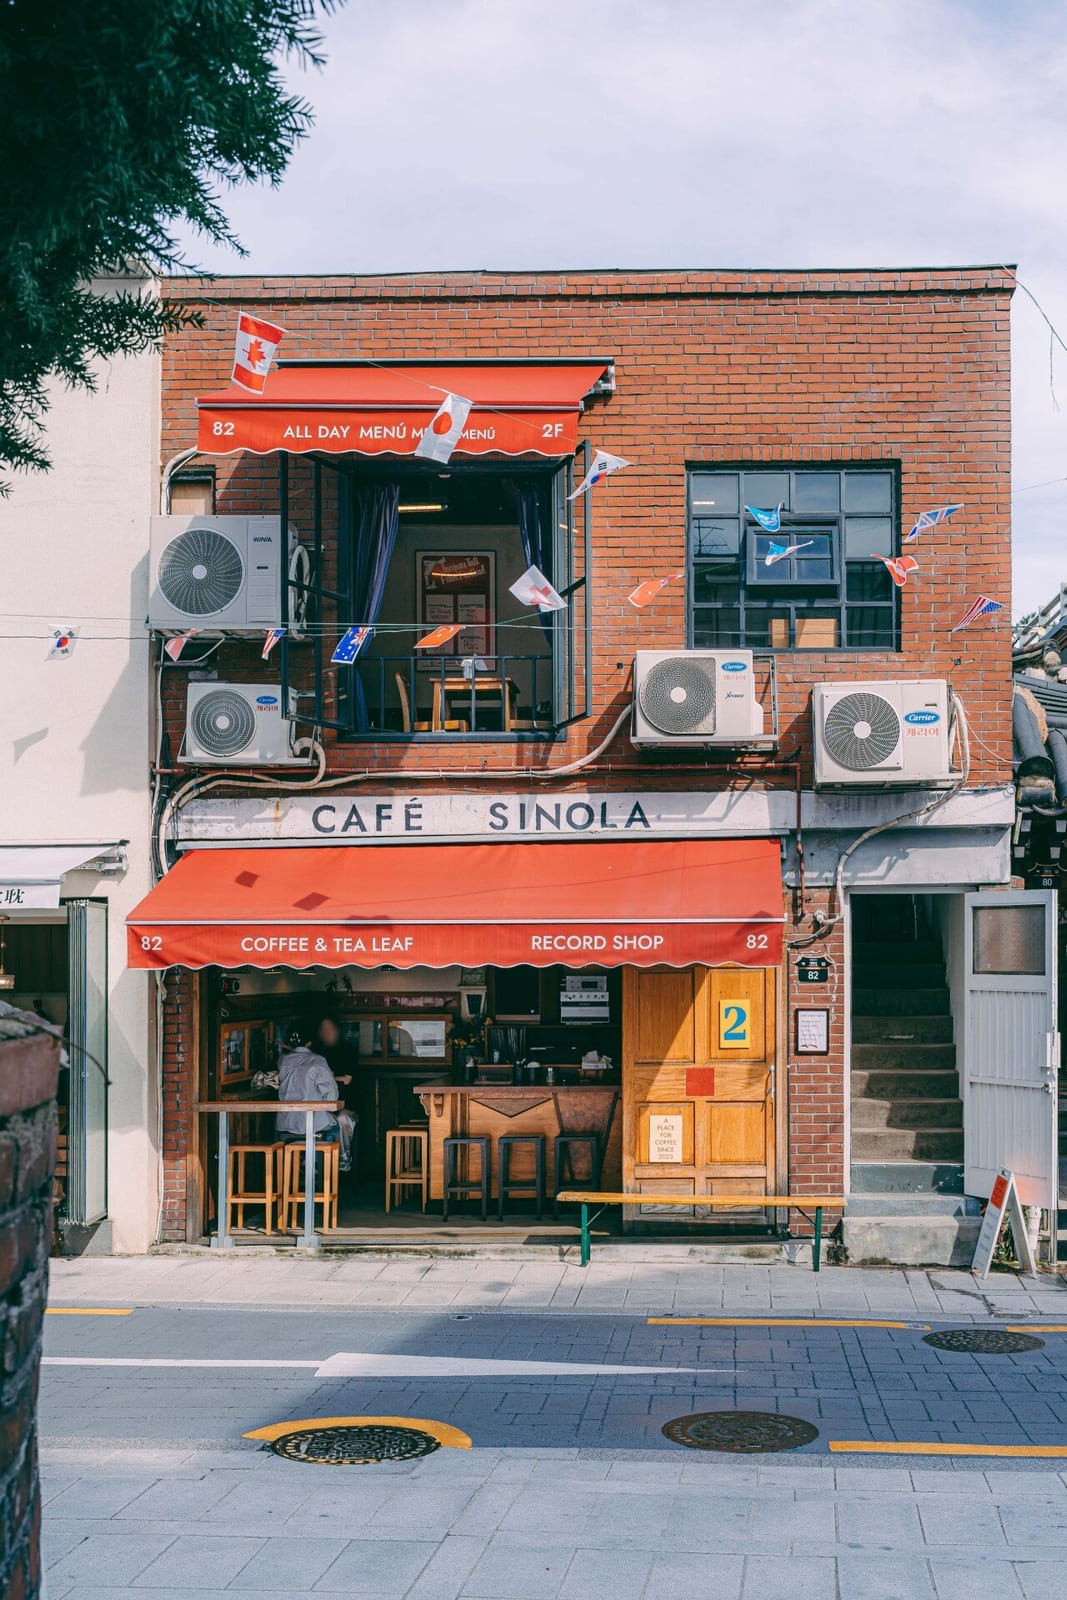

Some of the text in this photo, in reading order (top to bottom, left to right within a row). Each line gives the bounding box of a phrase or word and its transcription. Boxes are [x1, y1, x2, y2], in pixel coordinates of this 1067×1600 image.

[212, 421, 235, 436] 82
[283, 425, 312, 438] ALL
[318, 425, 350, 438] DAY
[359, 422, 407, 439] MENÚ
[541, 423, 564, 438] 2F
[908, 713, 936, 721] Carrier
[311, 796, 651, 833] CAFÉ SINOLA
[1042, 878, 1053, 887] 80
[141, 936, 163, 951] 82
[241, 936, 414, 952] COFFEE & TEA LEAF
[531, 935, 664, 950] RECORD SHOP
[745, 934, 769, 949] 82
[807, 970, 819, 980] 82
[723, 1006, 747, 1041] 2
